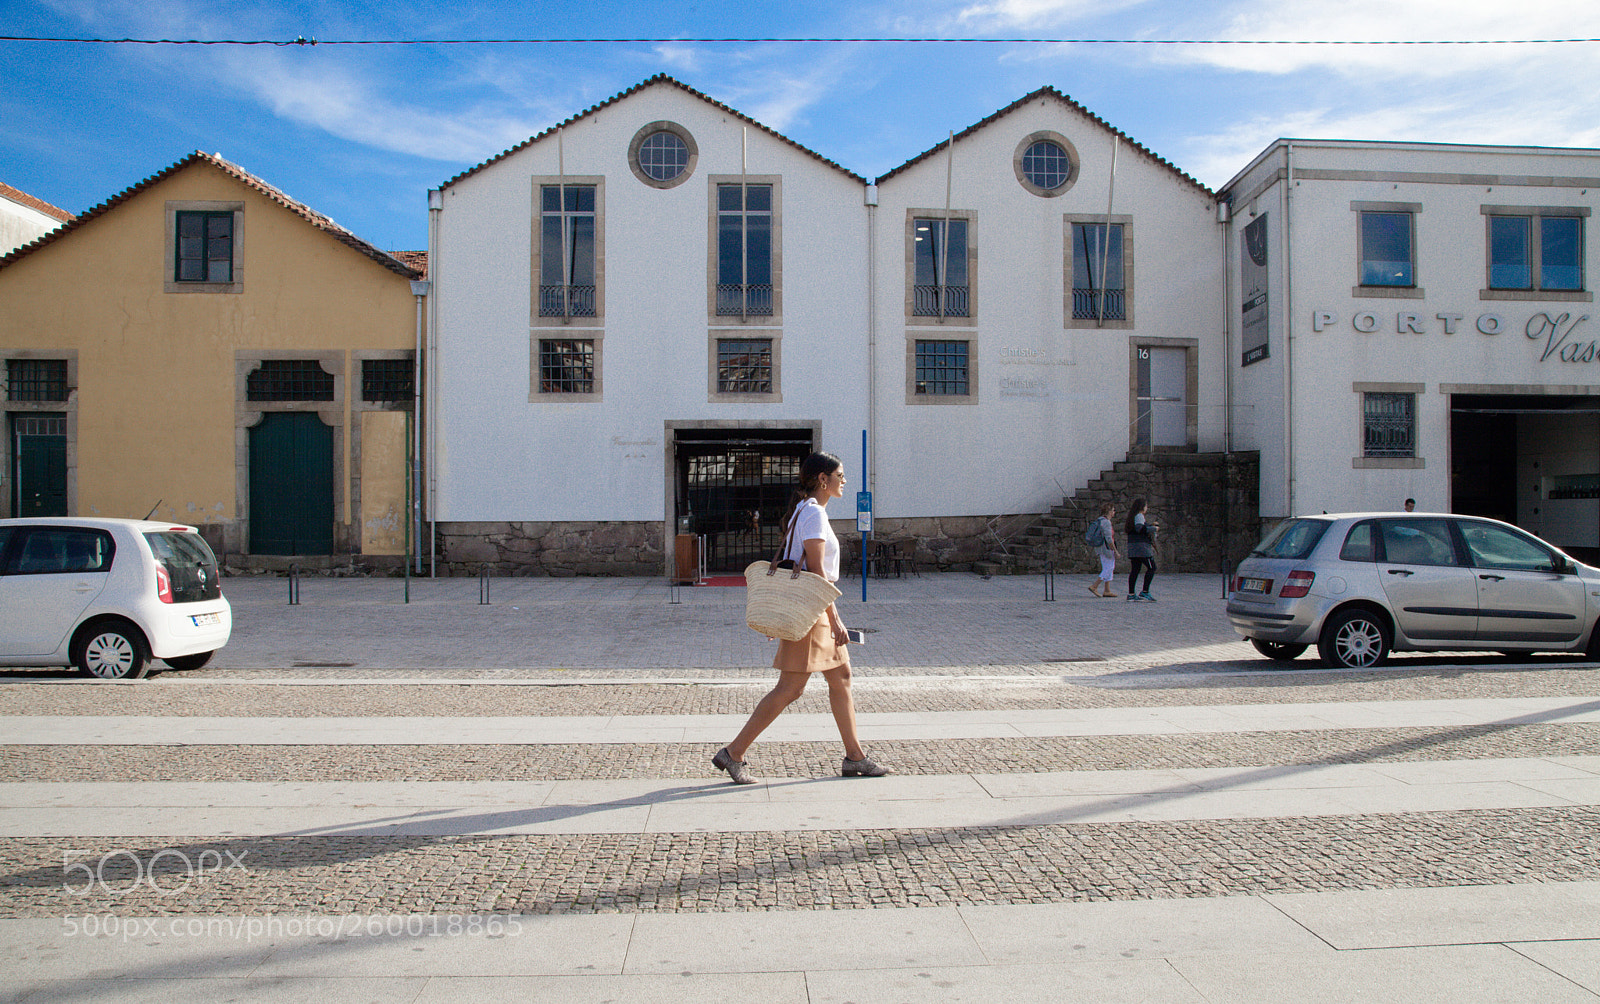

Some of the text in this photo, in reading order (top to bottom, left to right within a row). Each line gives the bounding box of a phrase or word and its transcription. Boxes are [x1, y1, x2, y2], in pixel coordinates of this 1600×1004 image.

[1312, 310, 1503, 335] PORTO
[999, 346, 1046, 357] Christie's
[1138, 348, 1149, 359] 16
